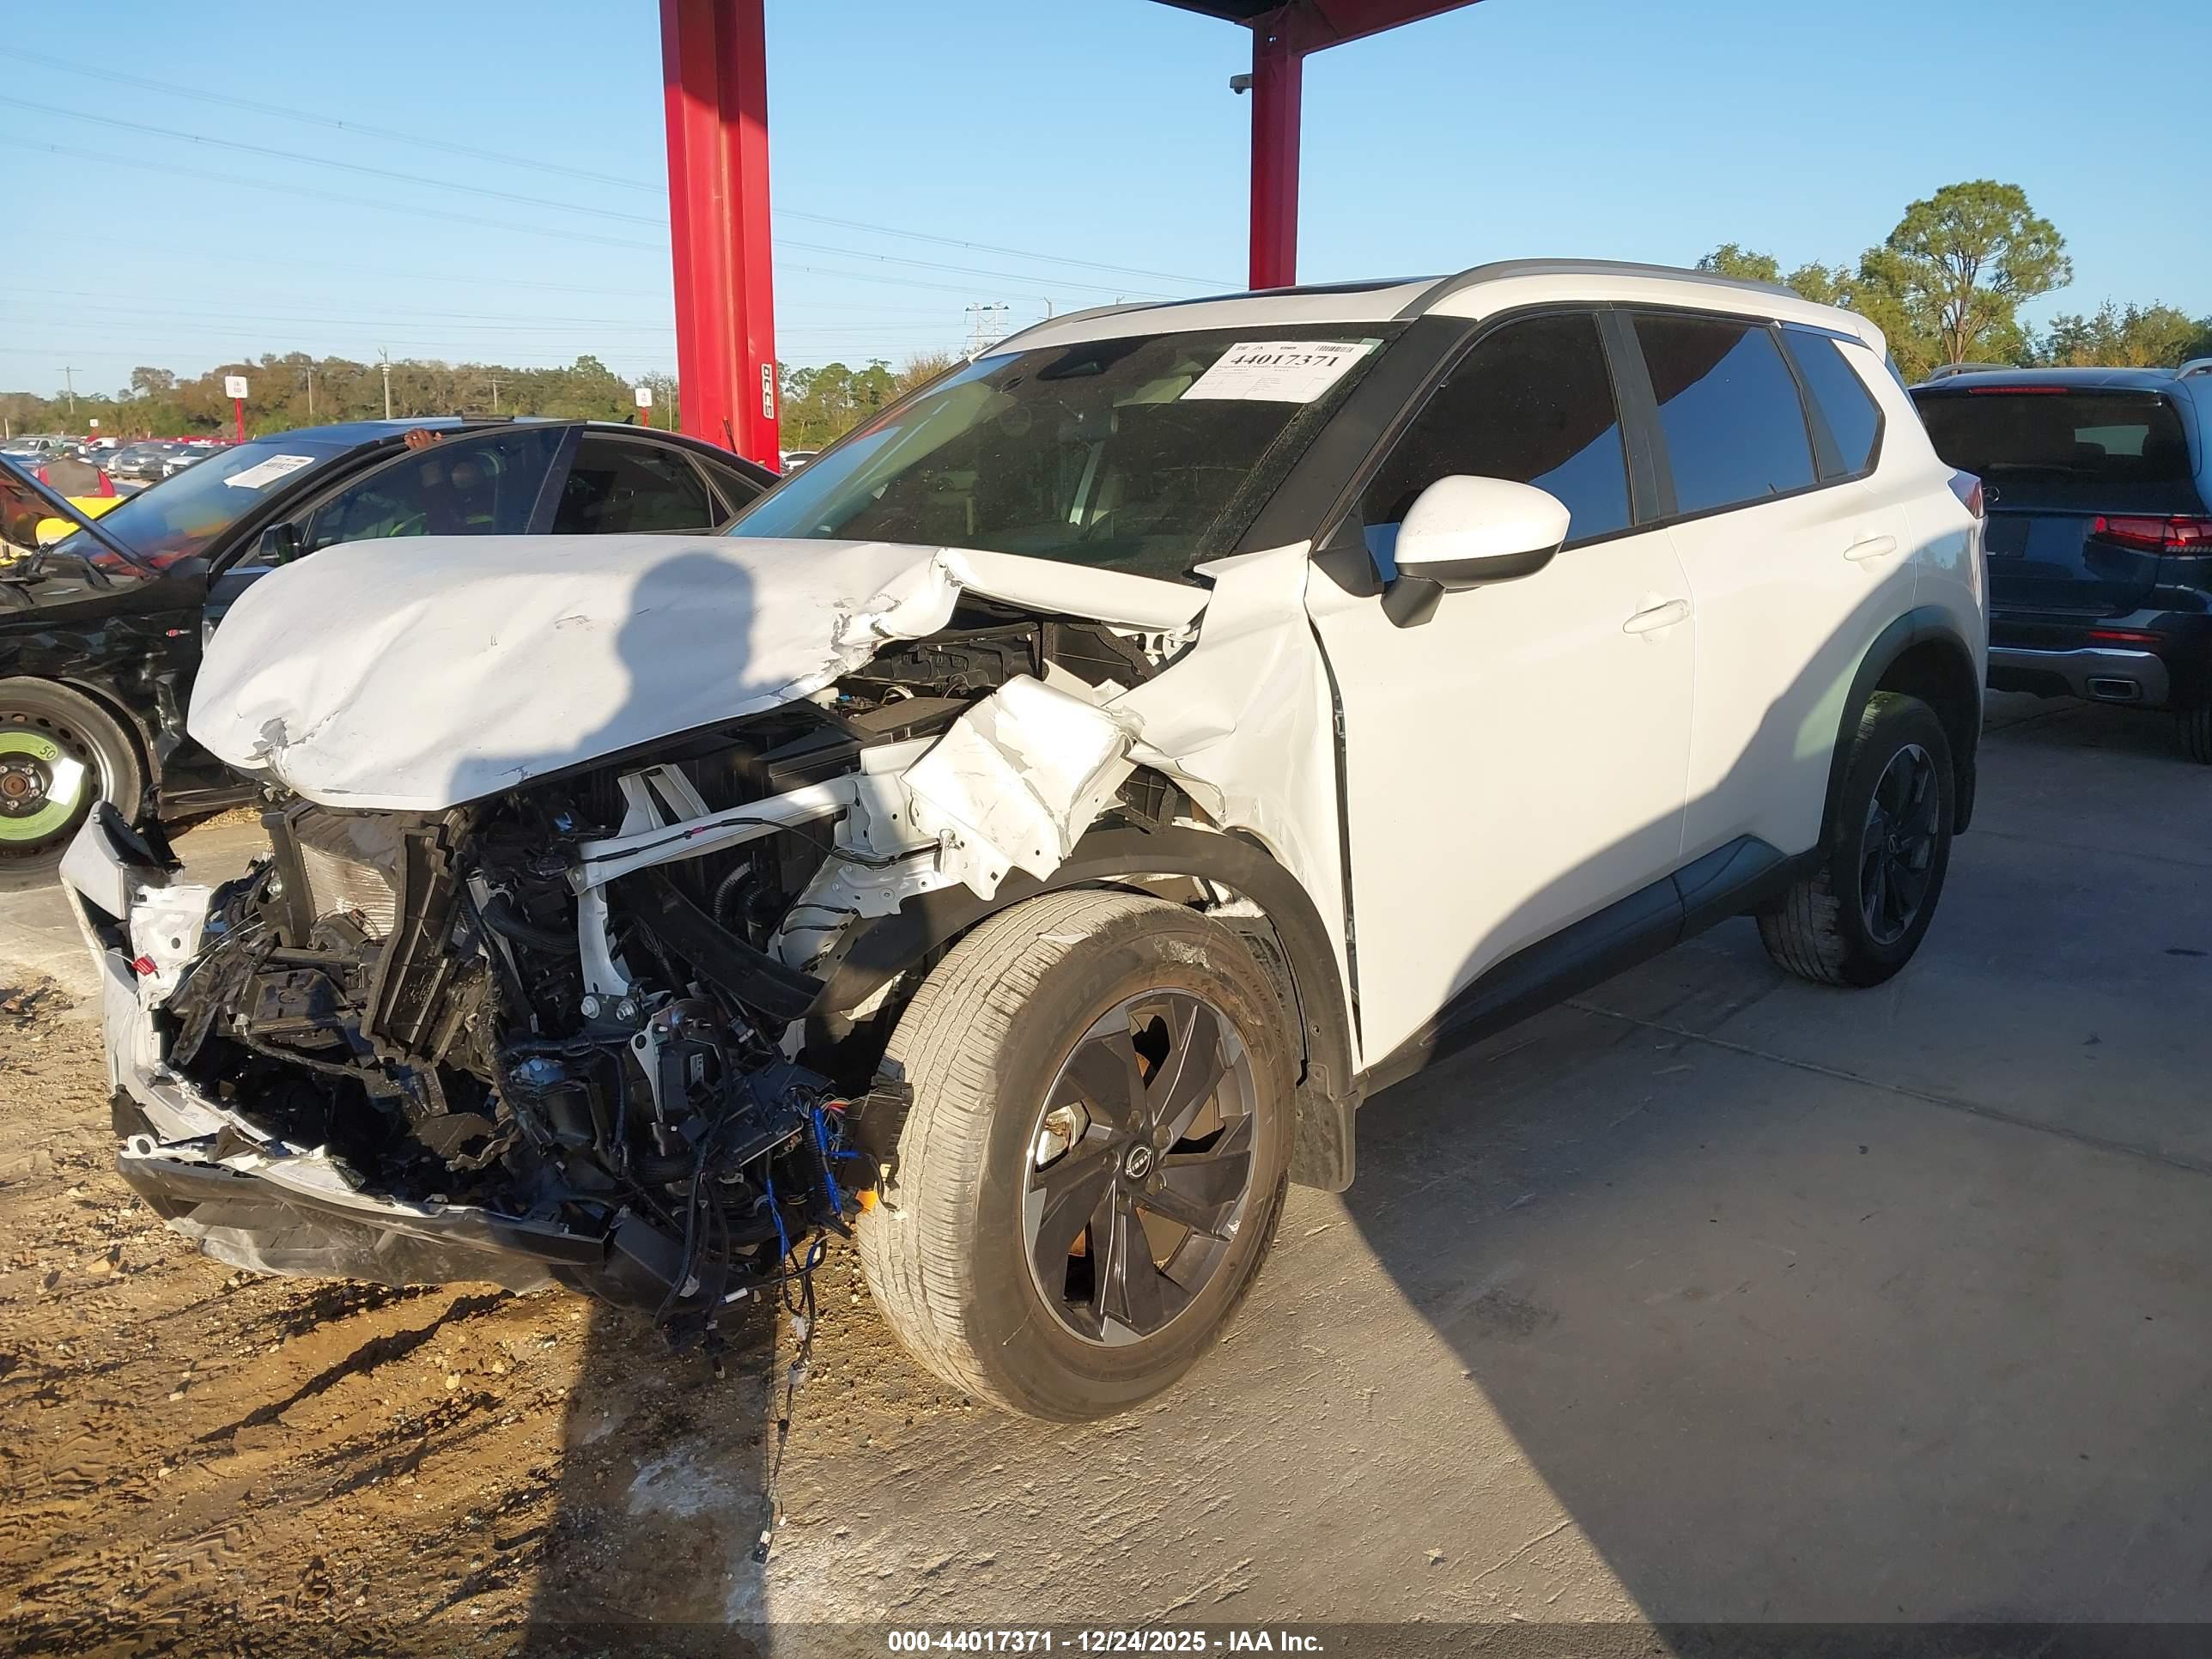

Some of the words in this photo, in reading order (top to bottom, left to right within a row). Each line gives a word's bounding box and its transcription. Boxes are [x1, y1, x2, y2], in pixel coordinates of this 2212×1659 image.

[1230, 354, 1339, 367] 44017371
[40, 746, 56, 759] 50
[1125, 1148, 1152, 1176] NISSAN
